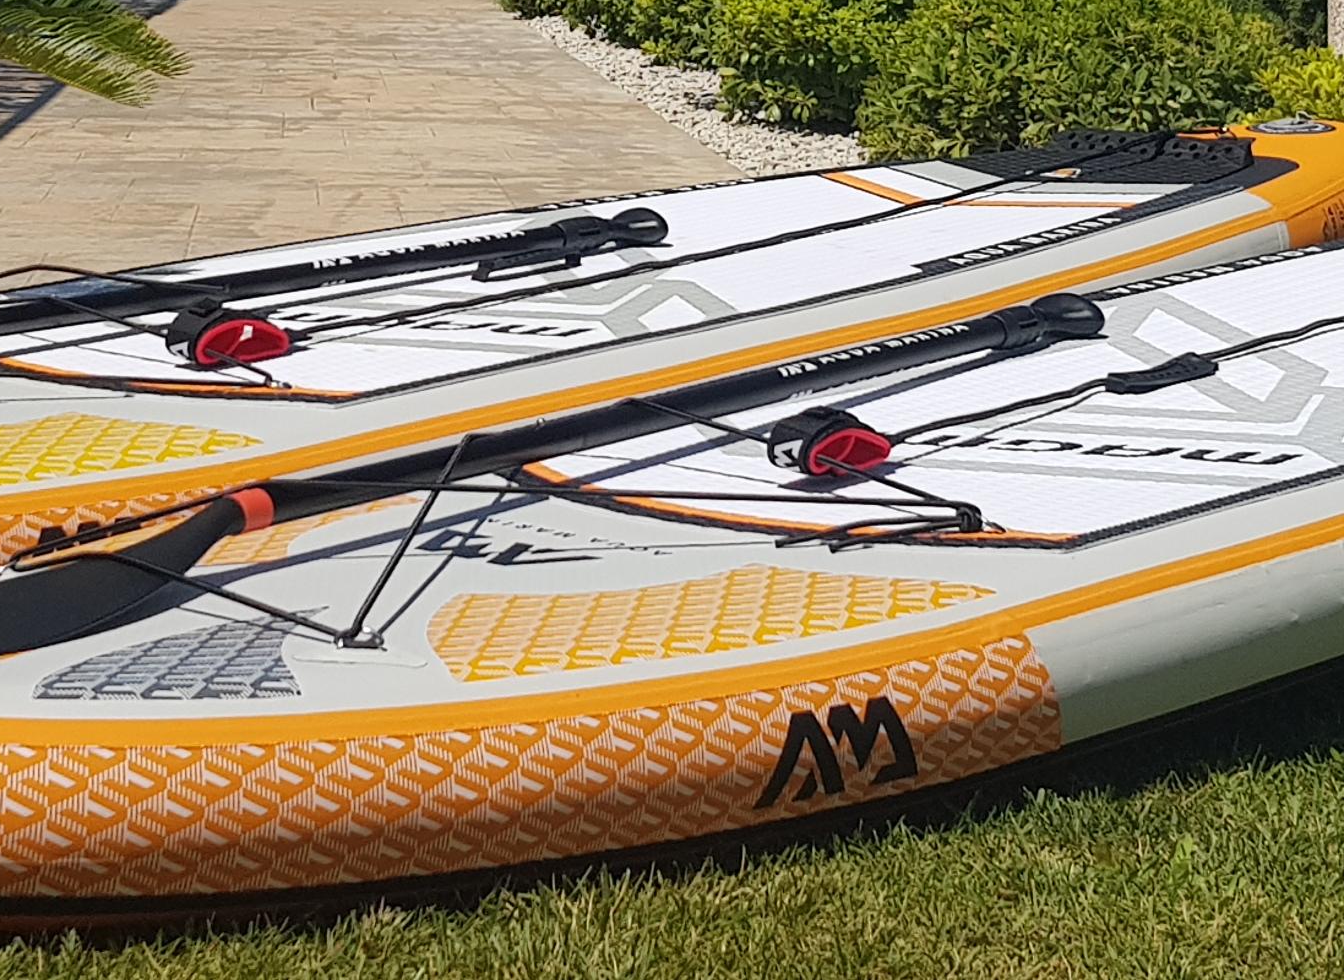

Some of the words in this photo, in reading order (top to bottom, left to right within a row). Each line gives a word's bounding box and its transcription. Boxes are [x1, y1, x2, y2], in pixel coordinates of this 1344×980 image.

[948, 243, 1023, 265] AQUA
[1019, 218, 1121, 245] MARINA
[753, 696, 918, 810] AM
